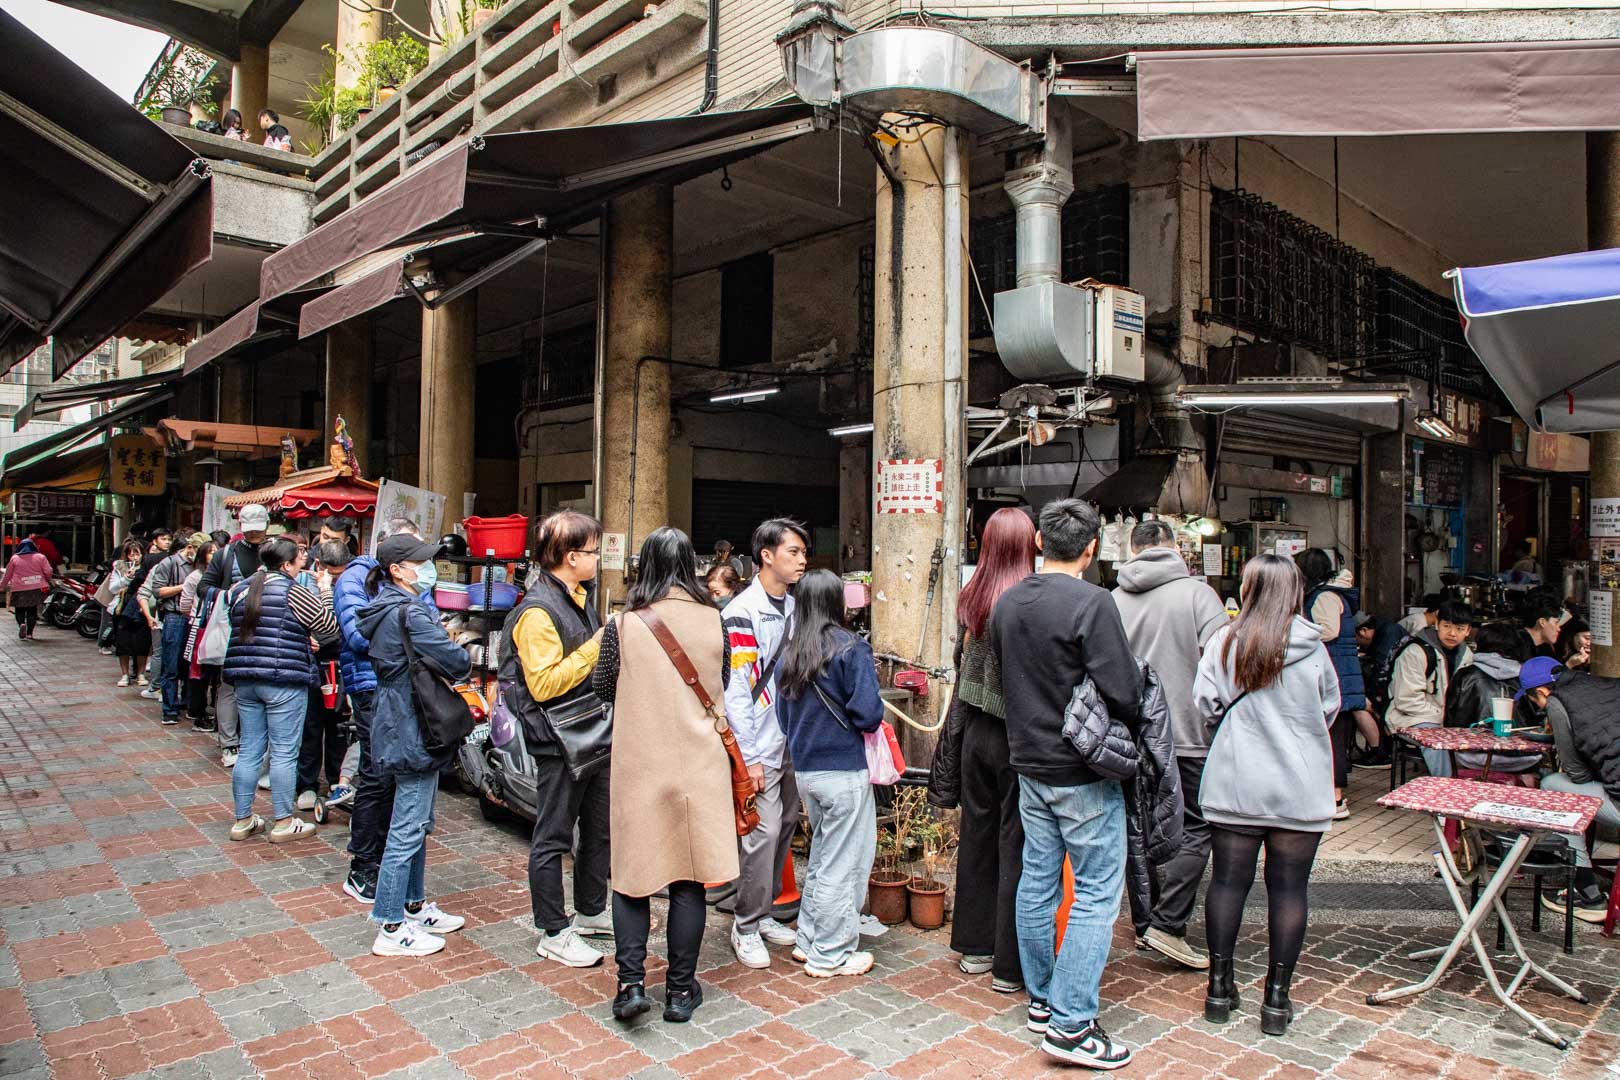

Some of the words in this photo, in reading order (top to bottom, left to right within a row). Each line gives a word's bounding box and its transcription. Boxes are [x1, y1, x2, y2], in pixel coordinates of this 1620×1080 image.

[891, 472, 920, 480] 永樂二樓
[891, 484, 920, 492] 請往上走
